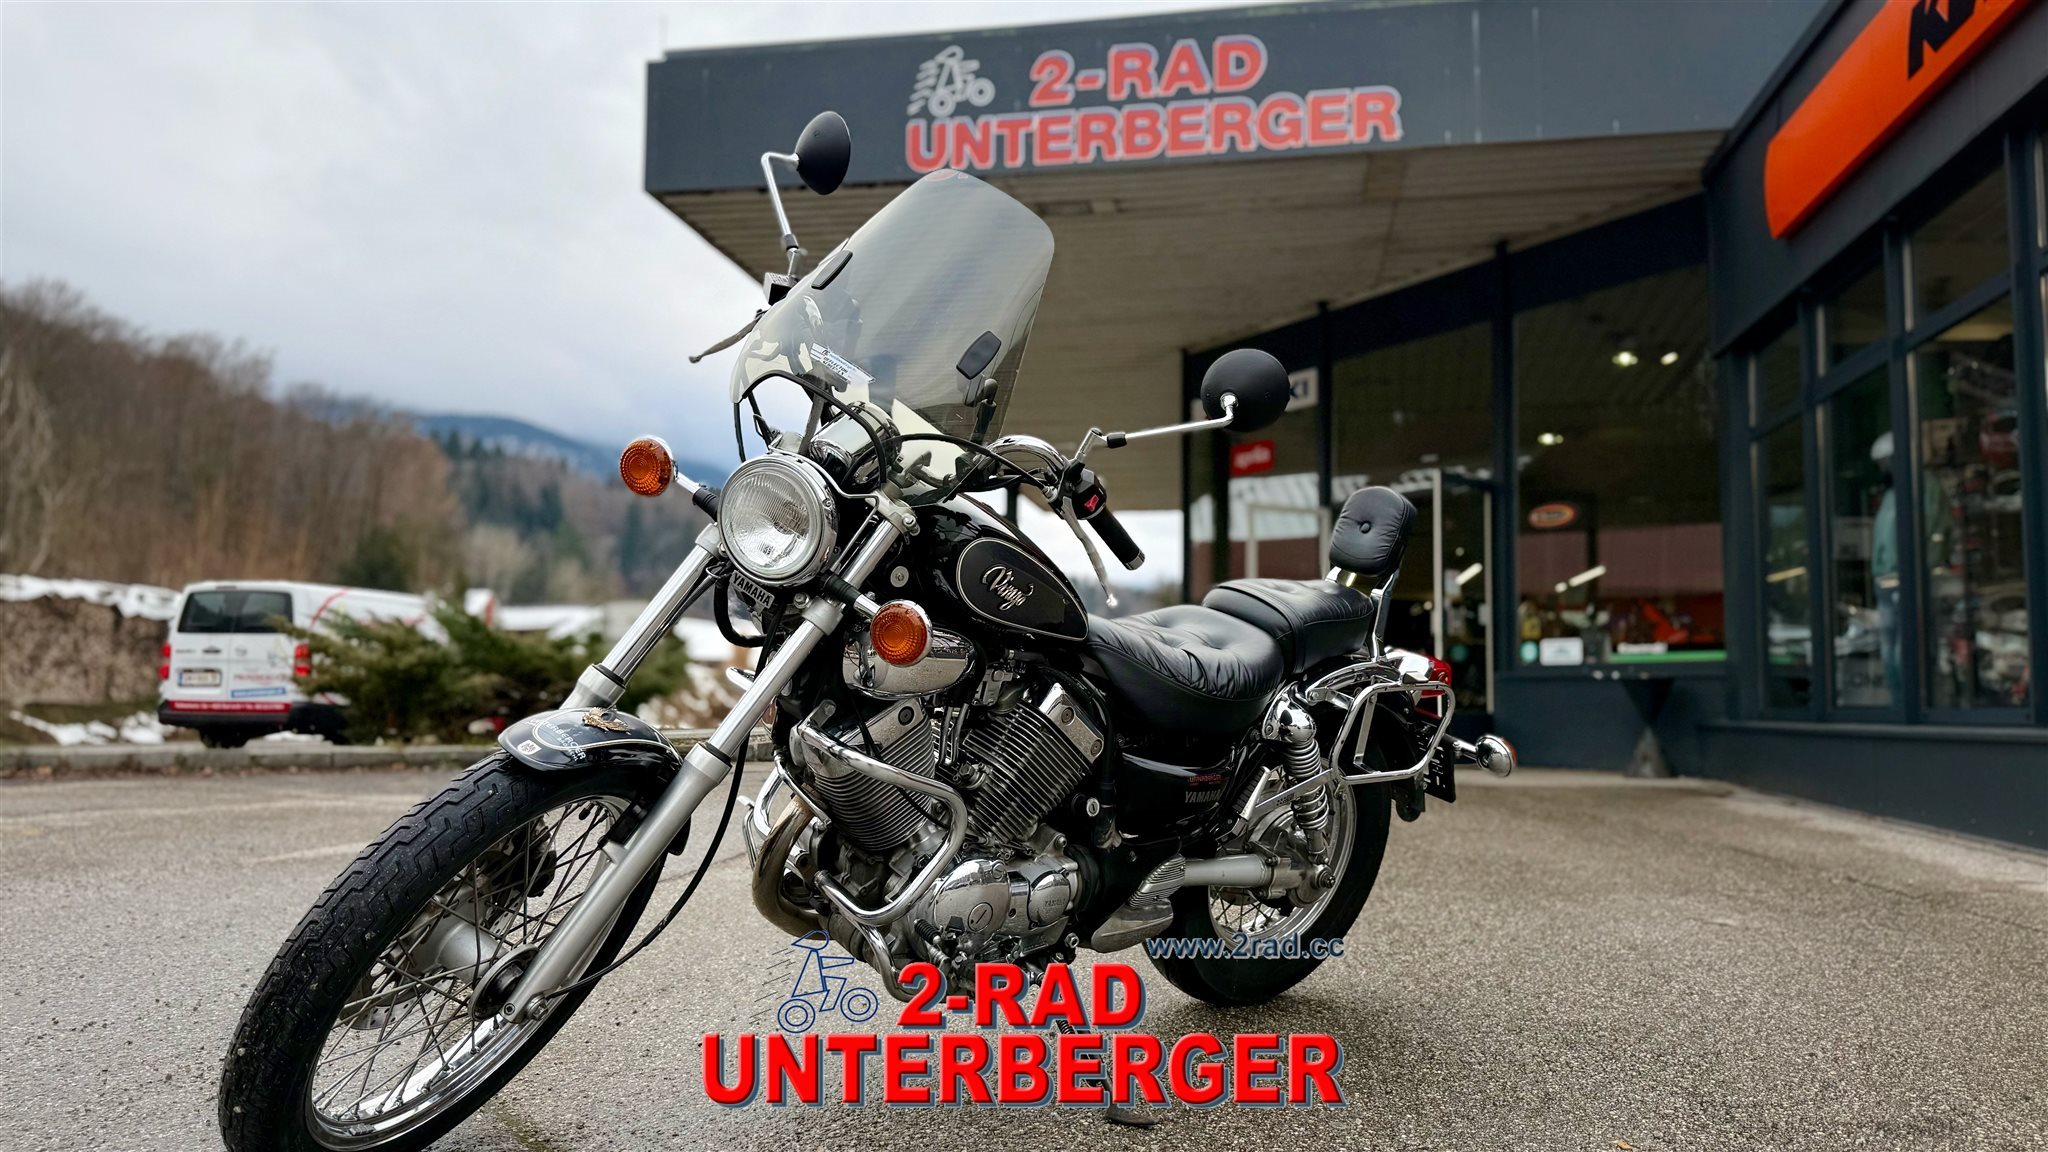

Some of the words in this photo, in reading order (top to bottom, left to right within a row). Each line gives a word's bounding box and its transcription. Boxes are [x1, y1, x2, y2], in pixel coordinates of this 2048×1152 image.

[1031, 37, 1266, 106] 2-RAD
[905, 86, 1401, 173] UNTERBERGER
[733, 572, 771, 607] YAMAHA
[1185, 789, 1221, 803] YAMAHA
